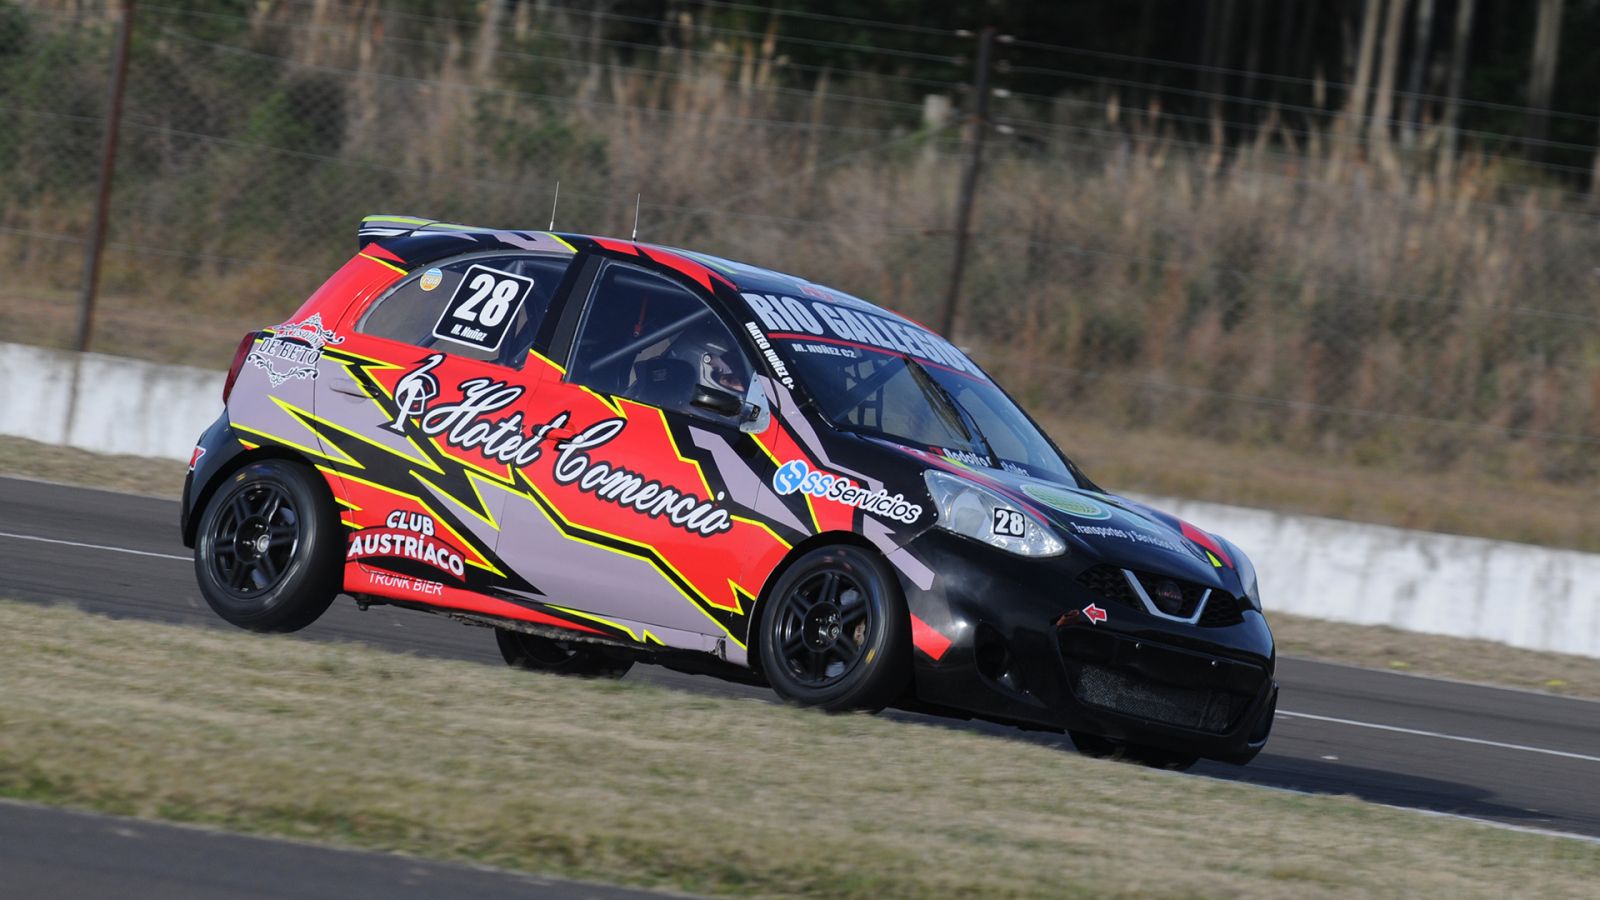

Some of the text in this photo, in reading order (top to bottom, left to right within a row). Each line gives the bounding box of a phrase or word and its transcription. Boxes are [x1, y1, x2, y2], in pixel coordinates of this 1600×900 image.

[452, 273, 520, 327] 28
[740, 293, 823, 335] RIO
[450, 323, 488, 342] M. Nuñez
[257, 337, 321, 366] DE BETO
[745, 321, 771, 350] MATEO
[763, 349, 789, 378] NUÑEZ
[791, 343, 808, 352] M.
[422, 377, 732, 535] Hotel Comercio
[386, 510, 434, 537] CLUB
[994, 509, 1024, 536] 28
[1070, 522, 1128, 539] Transportes
[347, 534, 465, 576] AUSTRÍACO
[369, 570, 444, 596] TRUNK BIER
